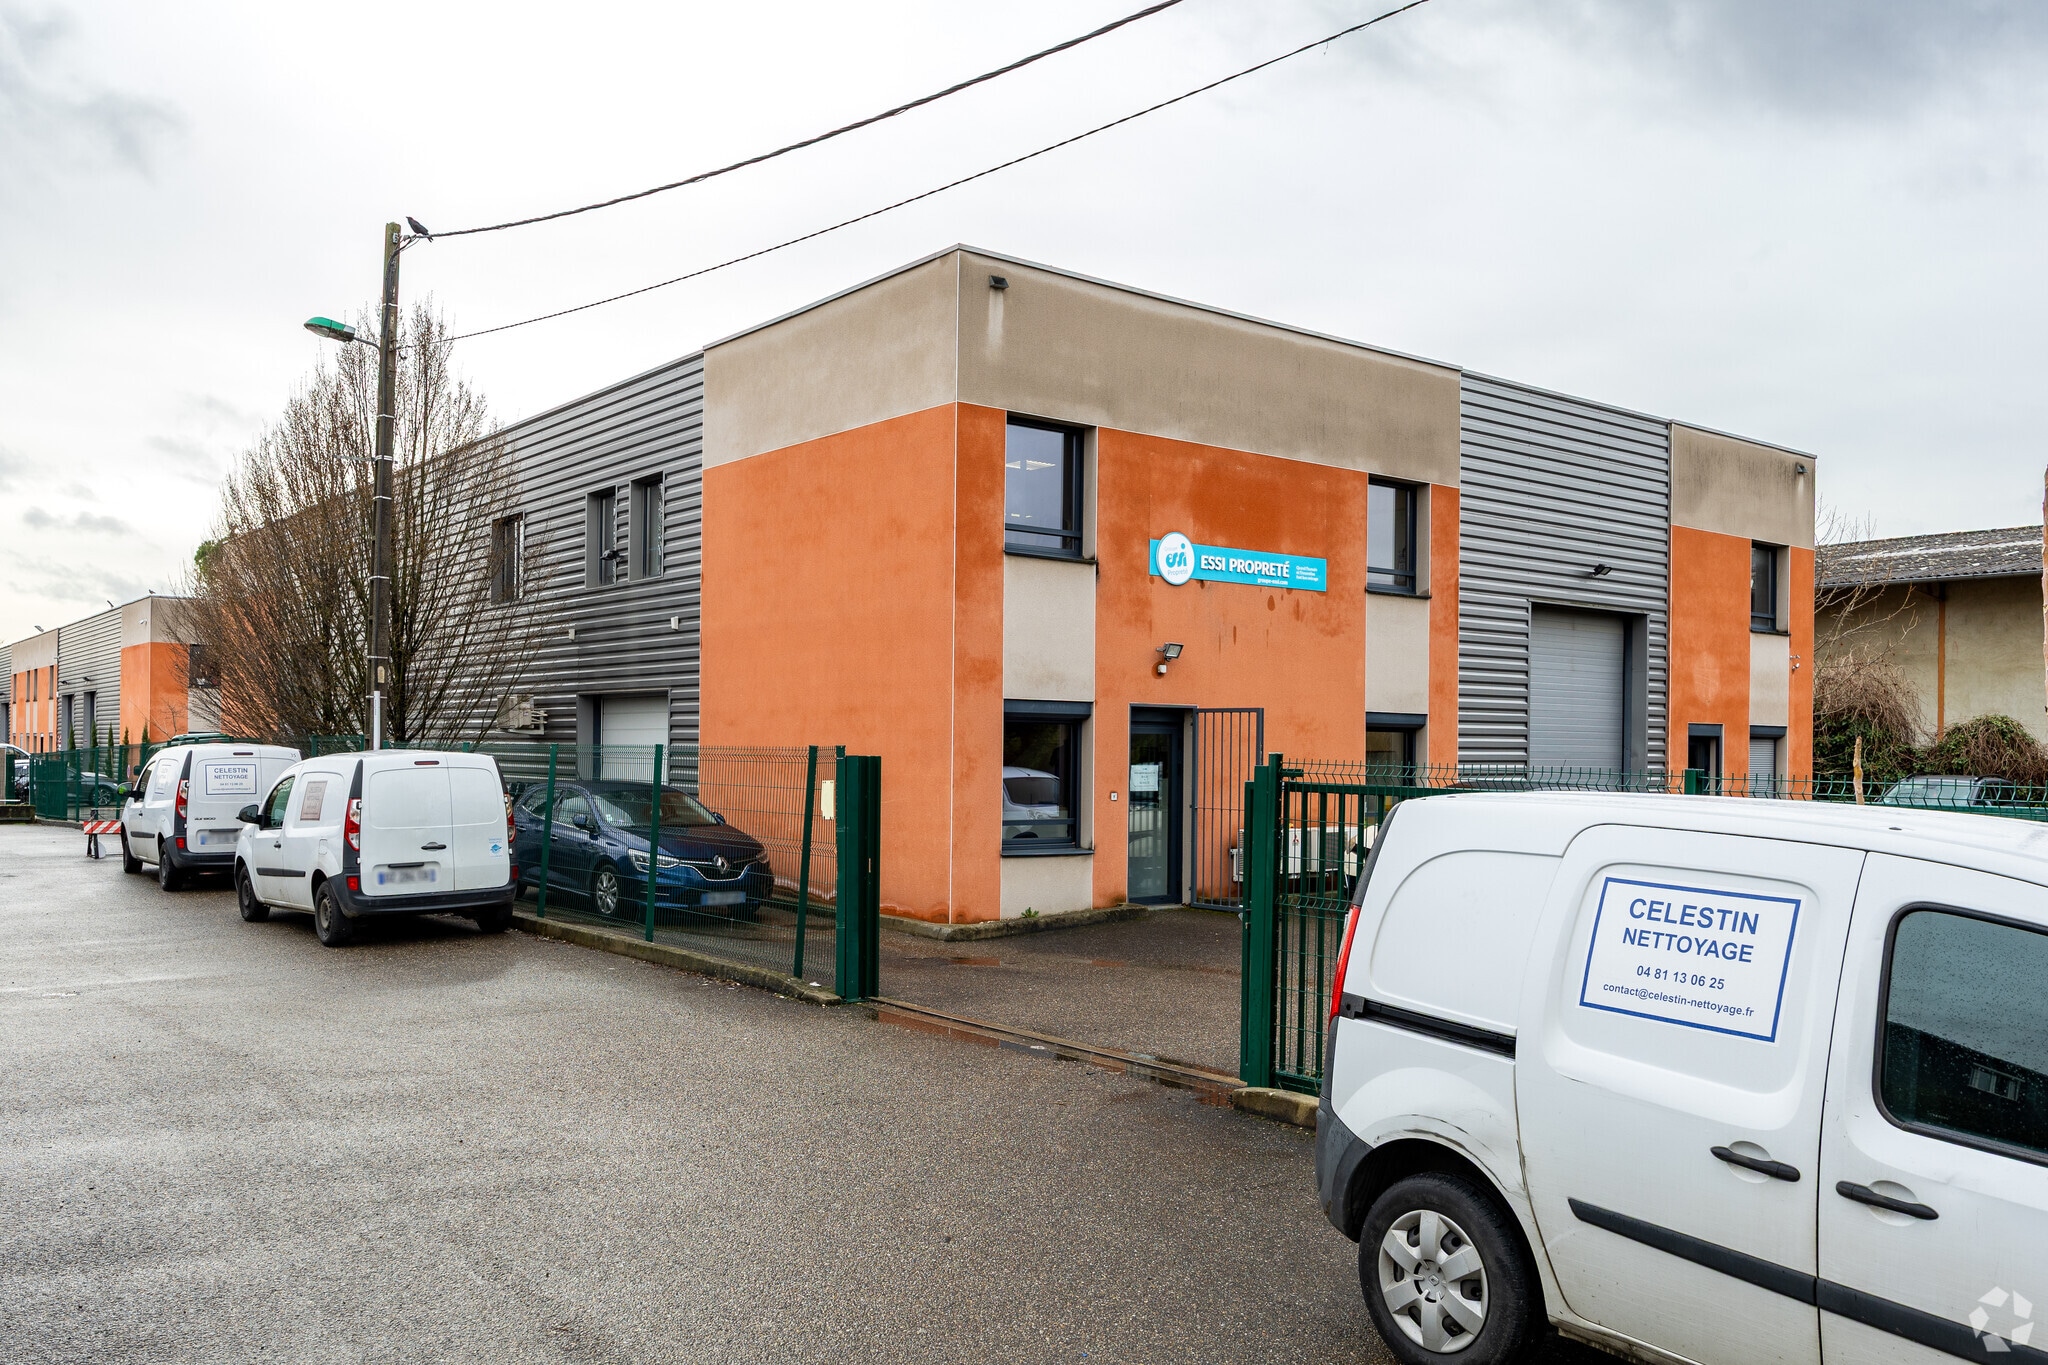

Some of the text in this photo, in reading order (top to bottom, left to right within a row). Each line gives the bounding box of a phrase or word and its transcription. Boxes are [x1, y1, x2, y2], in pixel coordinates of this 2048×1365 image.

[1200, 555, 1226, 571] ESSI
[1229, 558, 1290, 578] PROPRETÉ
[1629, 898, 1760, 935] CELESTIN
[1622, 927, 1755, 963] NETTOYAGE
[1636, 965, 1725, 990] 04 81 13 06 25
[1603, 983, 1755, 1017] contact@celestin-nettoyage.fr
